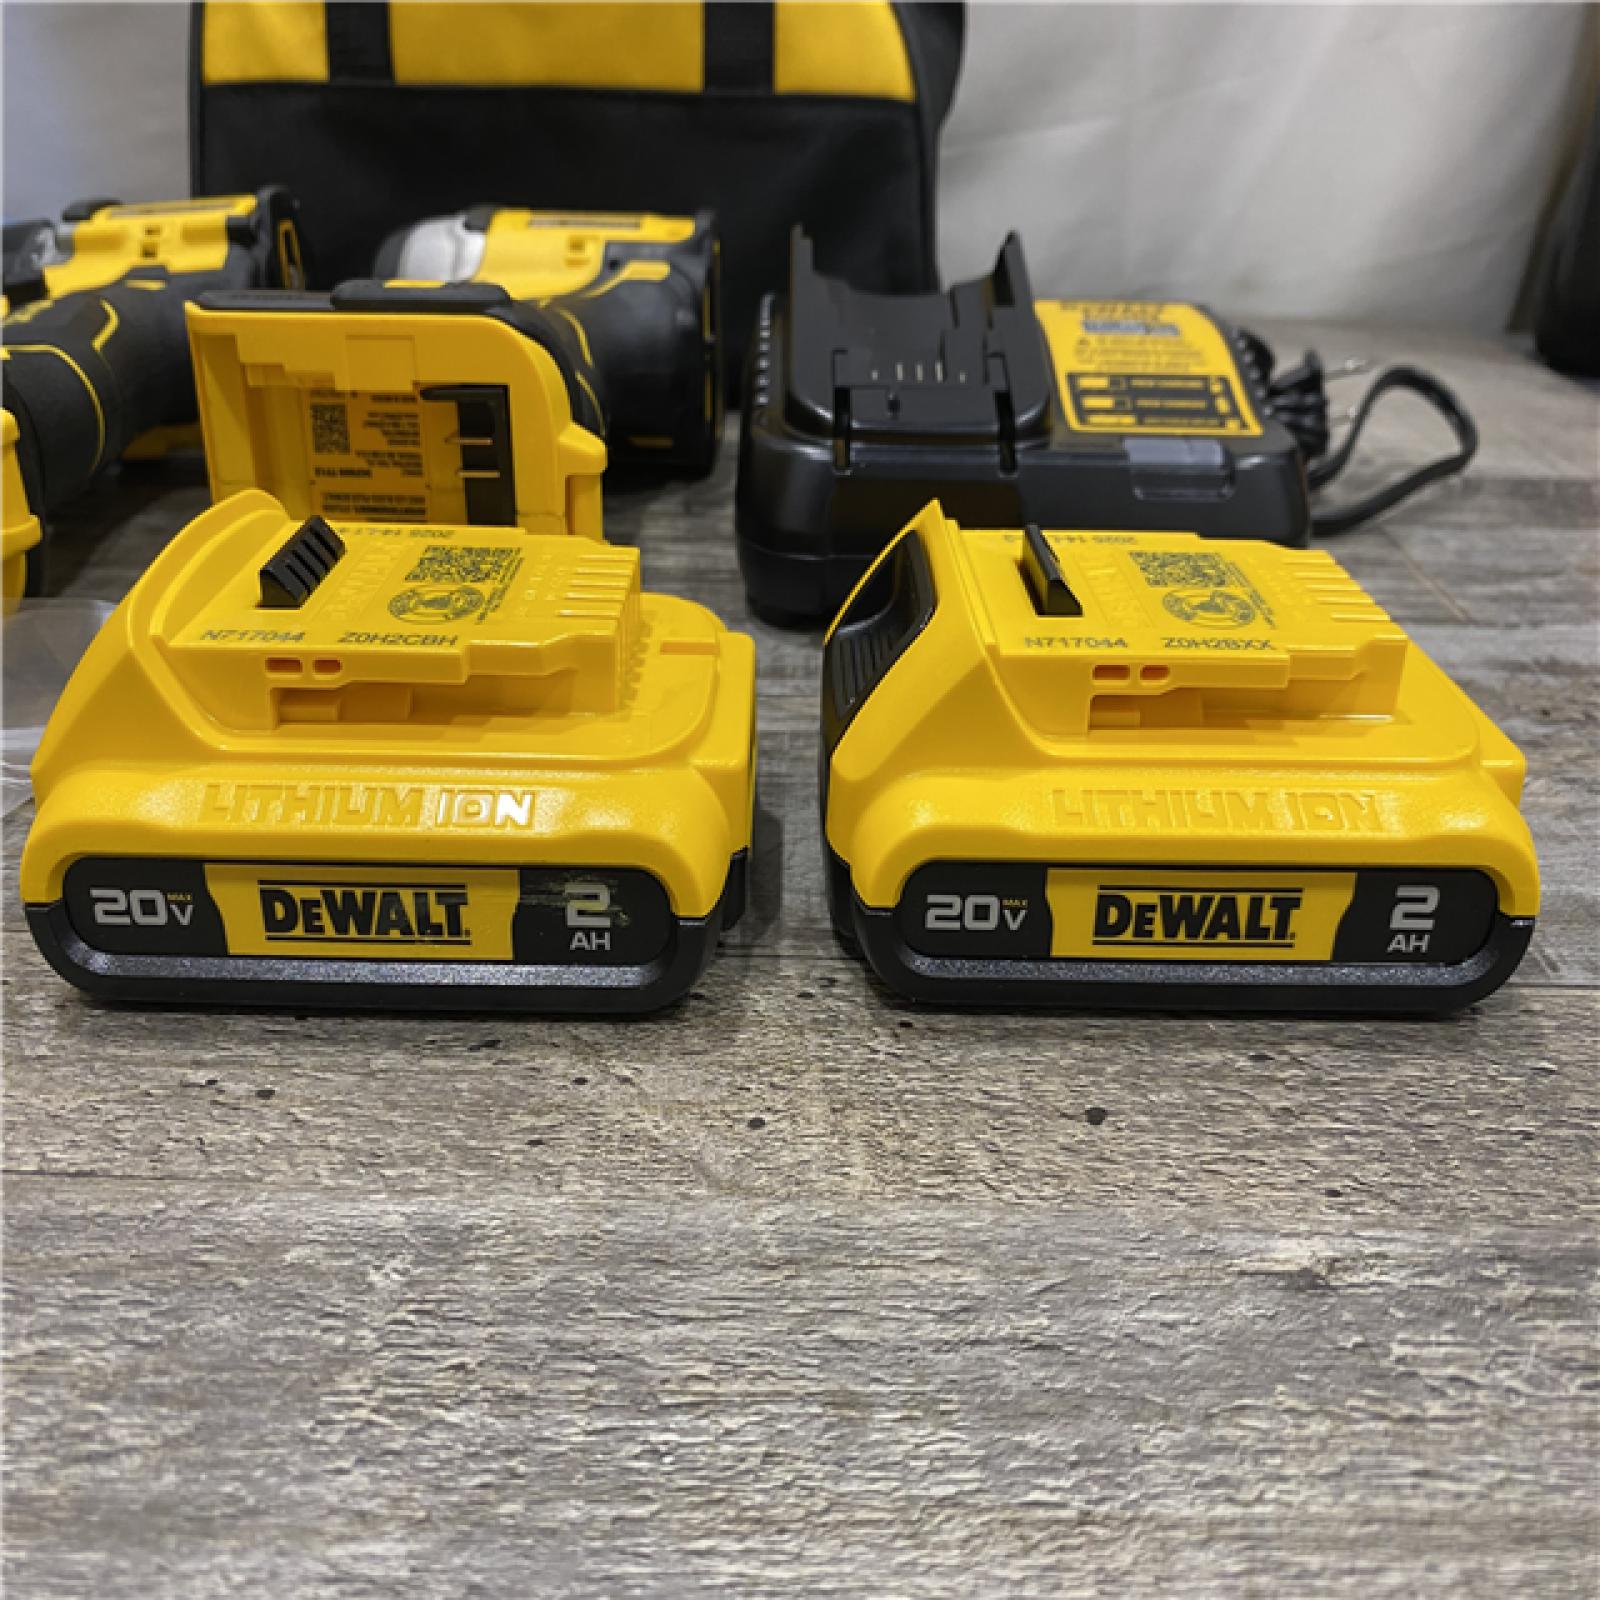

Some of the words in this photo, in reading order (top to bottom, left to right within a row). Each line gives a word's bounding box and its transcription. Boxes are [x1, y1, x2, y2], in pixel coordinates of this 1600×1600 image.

[197, 784, 420, 827] LITHIUM
[435, 789, 536, 828] ION
[1049, 788, 1275, 830] LITHIUM
[1284, 791, 1383, 832] ION
[565, 885, 612, 928] 2
[1389, 886, 1440, 930] 2
[569, 931, 612, 952] AH
[1387, 935, 1428, 954] AH
